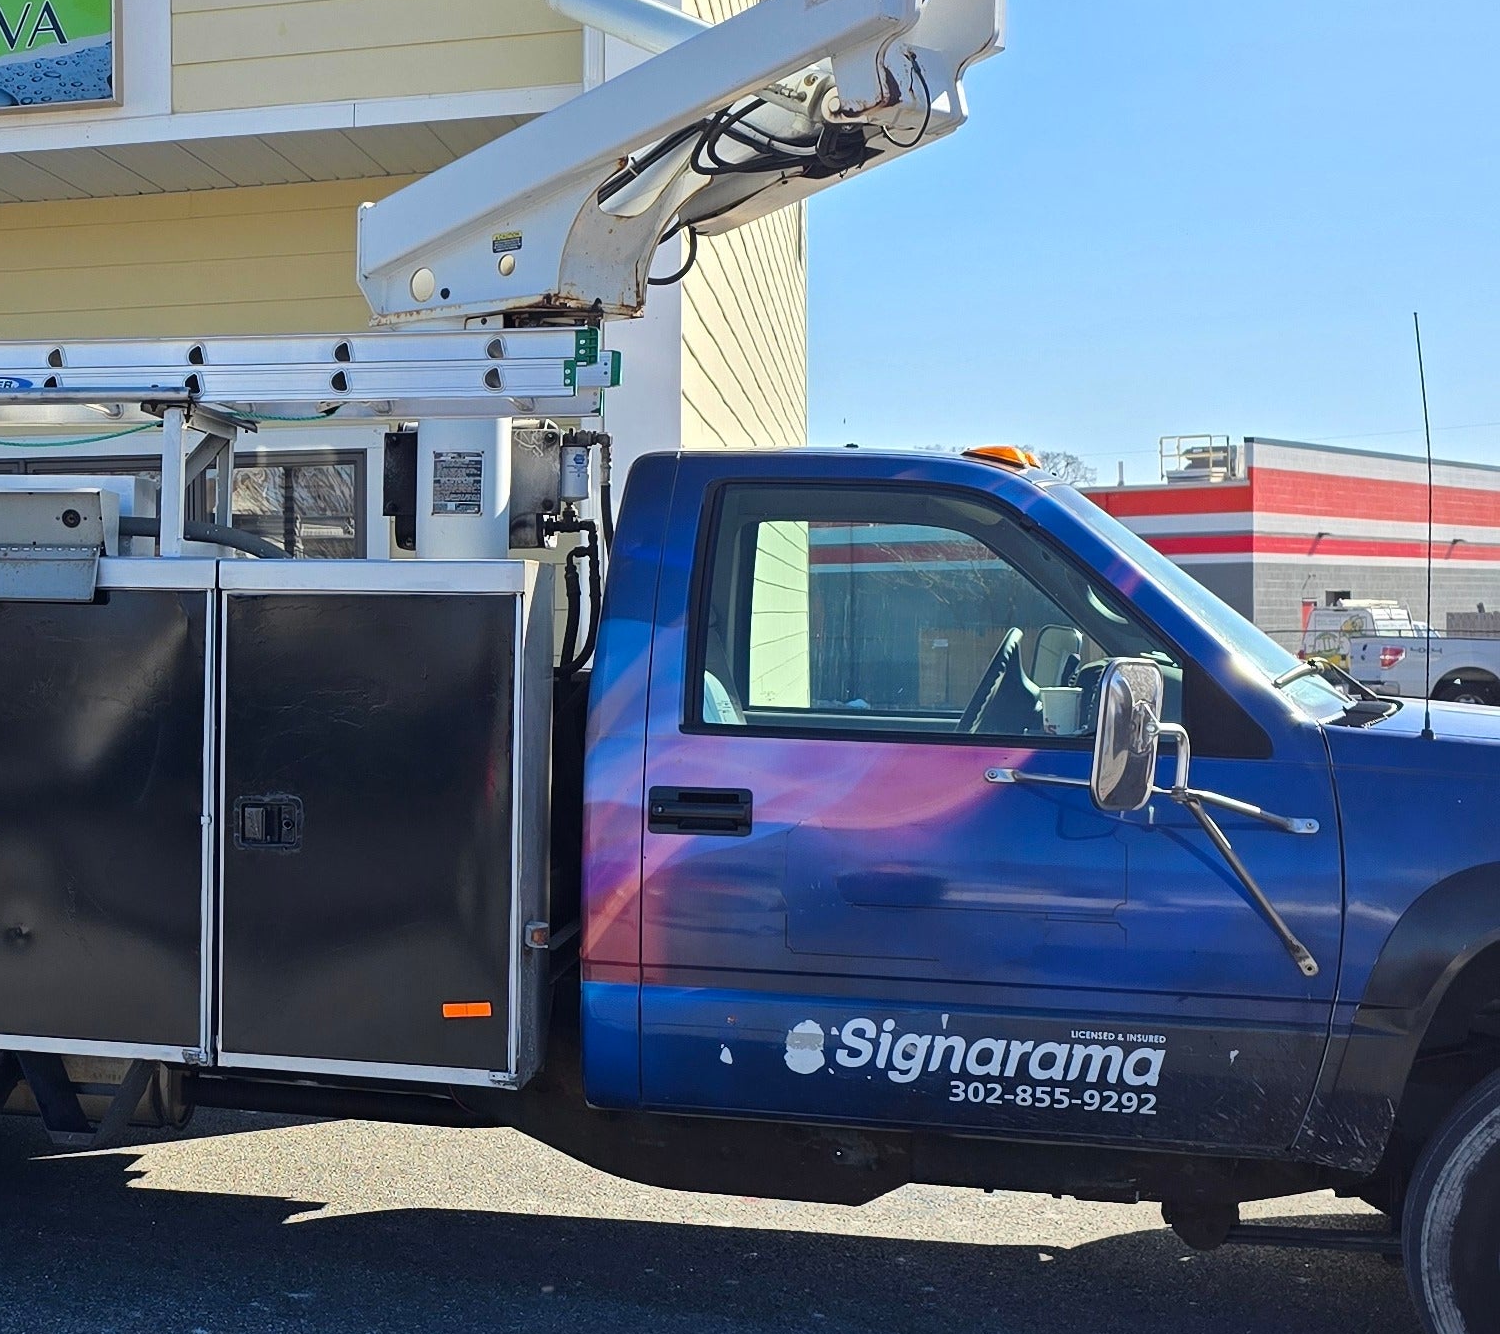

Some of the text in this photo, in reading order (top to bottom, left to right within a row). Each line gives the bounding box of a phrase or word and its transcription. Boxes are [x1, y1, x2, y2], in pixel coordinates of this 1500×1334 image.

[835, 1018, 1167, 1087] Signarama
[1071, 1030, 1167, 1044] LICENSED & INSURED
[948, 1081, 1158, 1116] 302-855-9292
